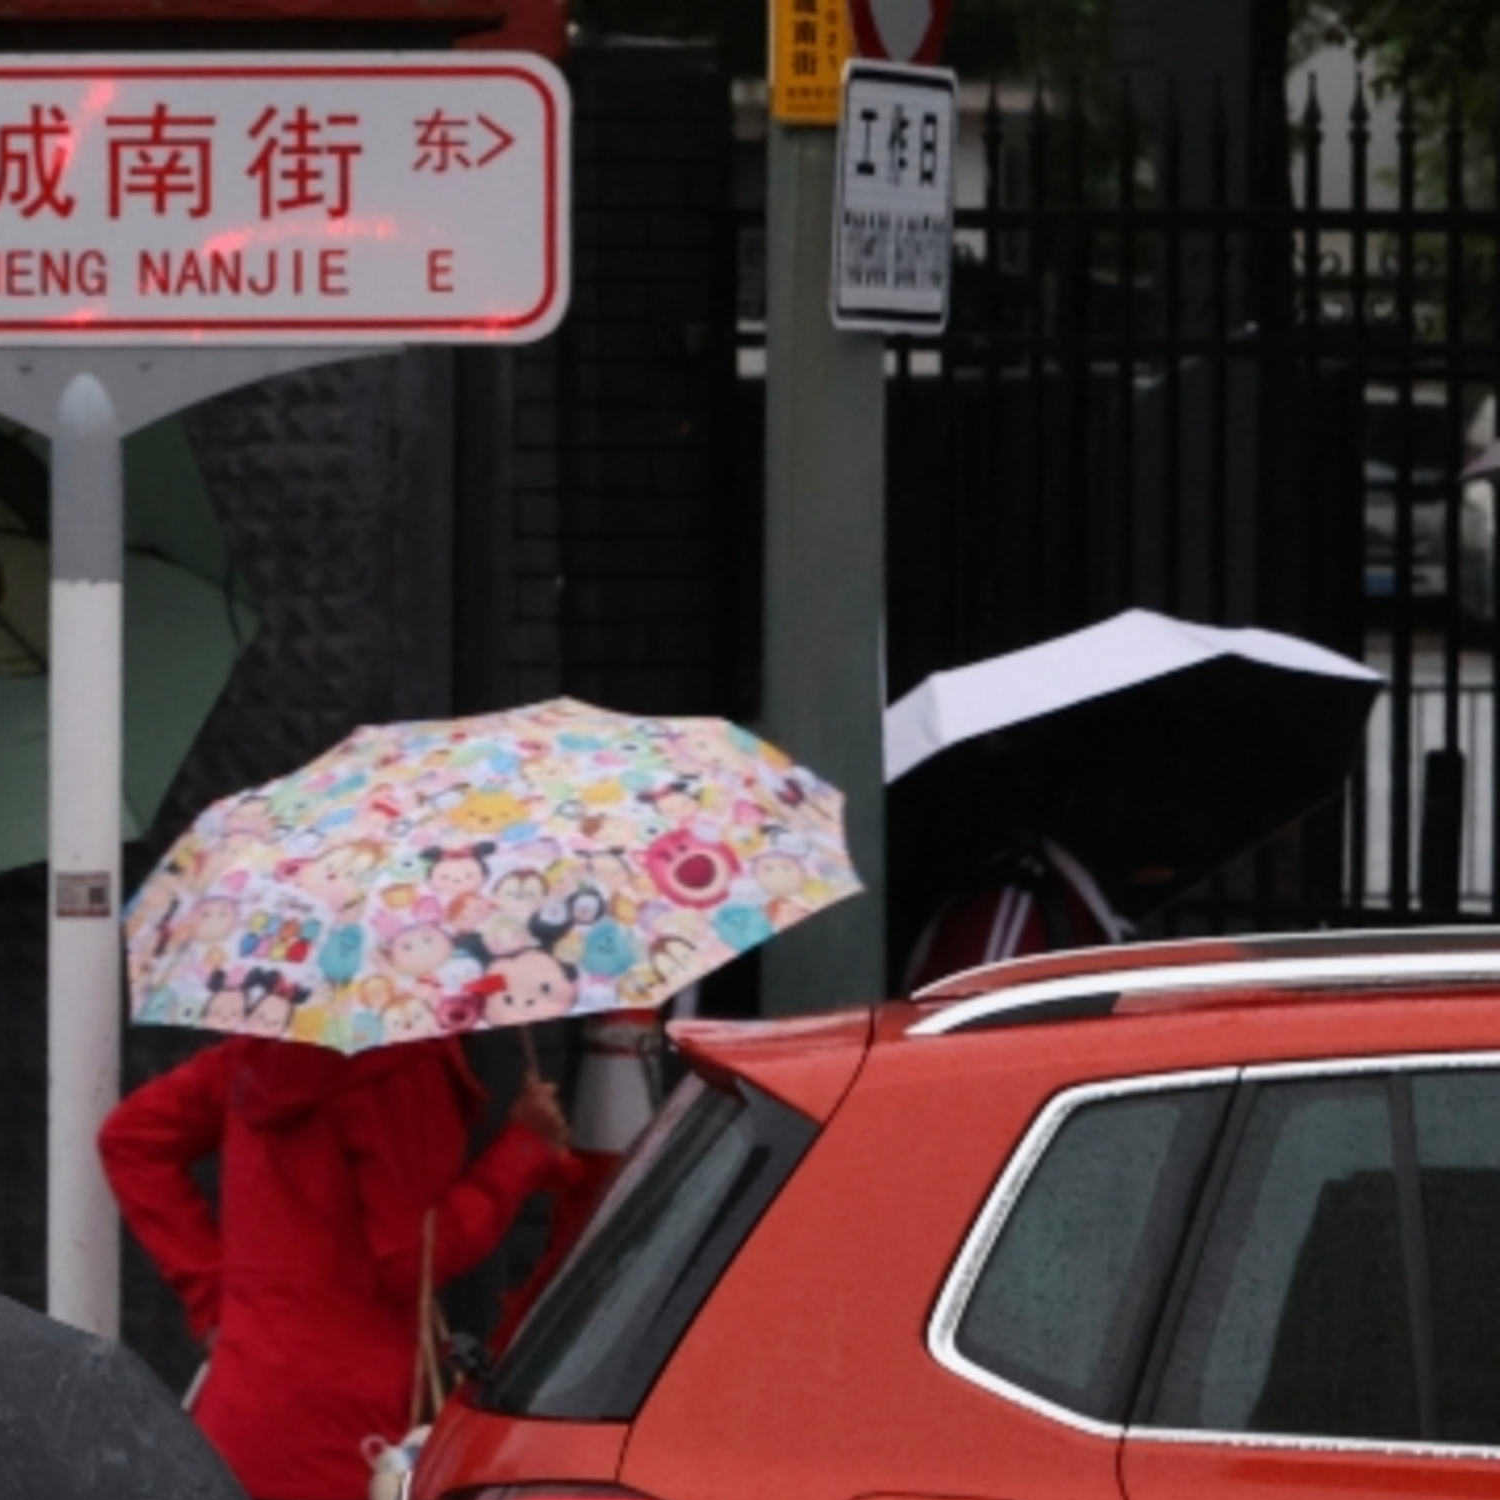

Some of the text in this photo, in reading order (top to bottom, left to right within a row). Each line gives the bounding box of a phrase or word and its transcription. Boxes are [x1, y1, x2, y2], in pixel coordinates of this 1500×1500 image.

[413, 109, 471, 174] 东
[855, 104, 938, 186] 工作日
[138, 249, 348, 296] NANJIE
[427, 250, 454, 293] E
